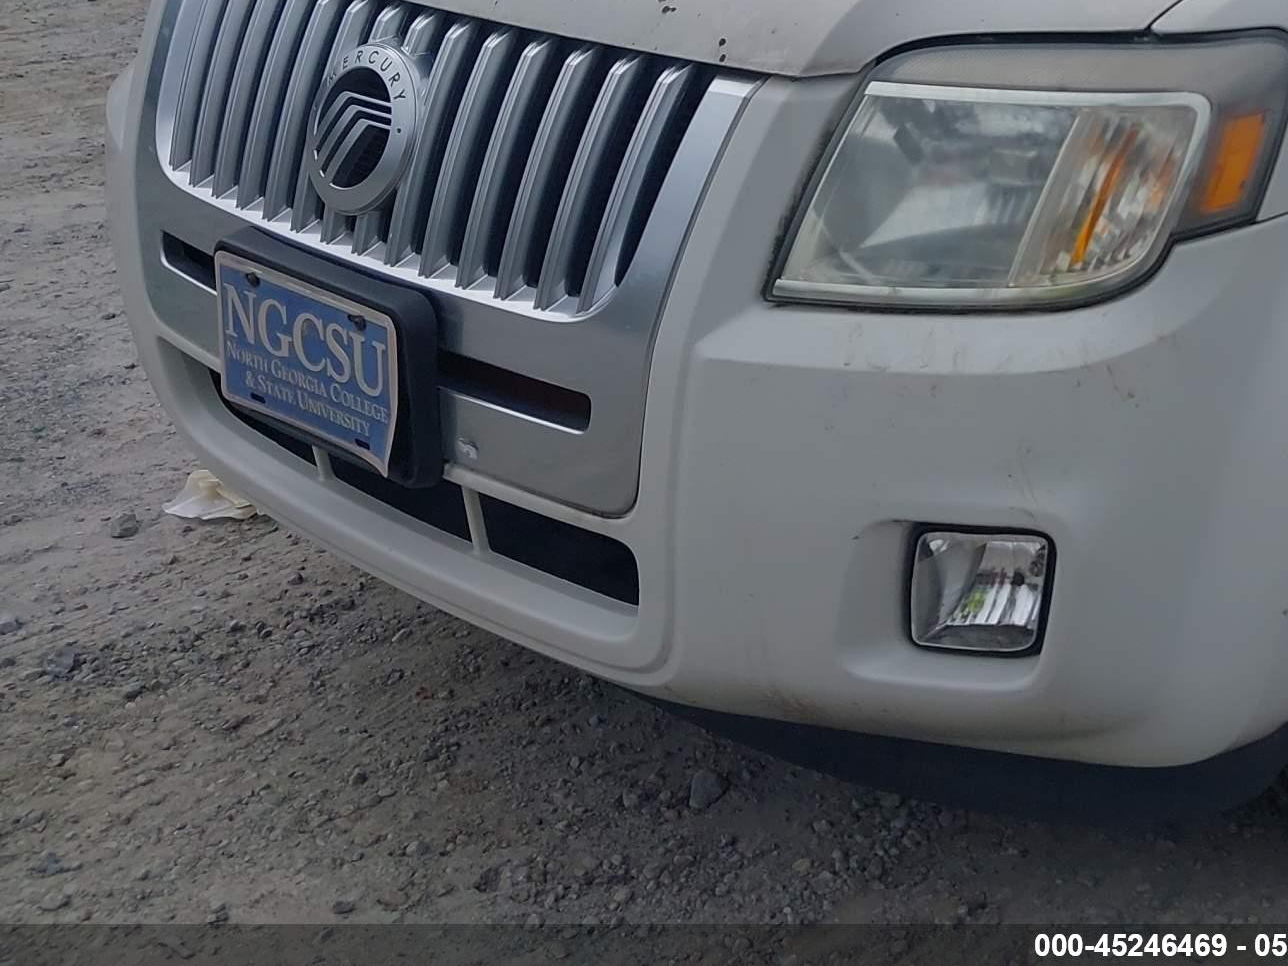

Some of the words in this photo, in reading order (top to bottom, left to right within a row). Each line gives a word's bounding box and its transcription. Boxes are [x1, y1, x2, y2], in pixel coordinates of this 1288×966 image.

[327, 50, 407, 101] MERCURY
[222, 282, 386, 397] NGCSU
[226, 340, 269, 373] NORTH
[271, 358, 327, 398] GEORGIA
[329, 383, 388, 424] COLLEGE
[245, 370, 256, 389] &
[258, 375, 296, 404] STATE
[297, 391, 370, 437] UNIVERSITY
